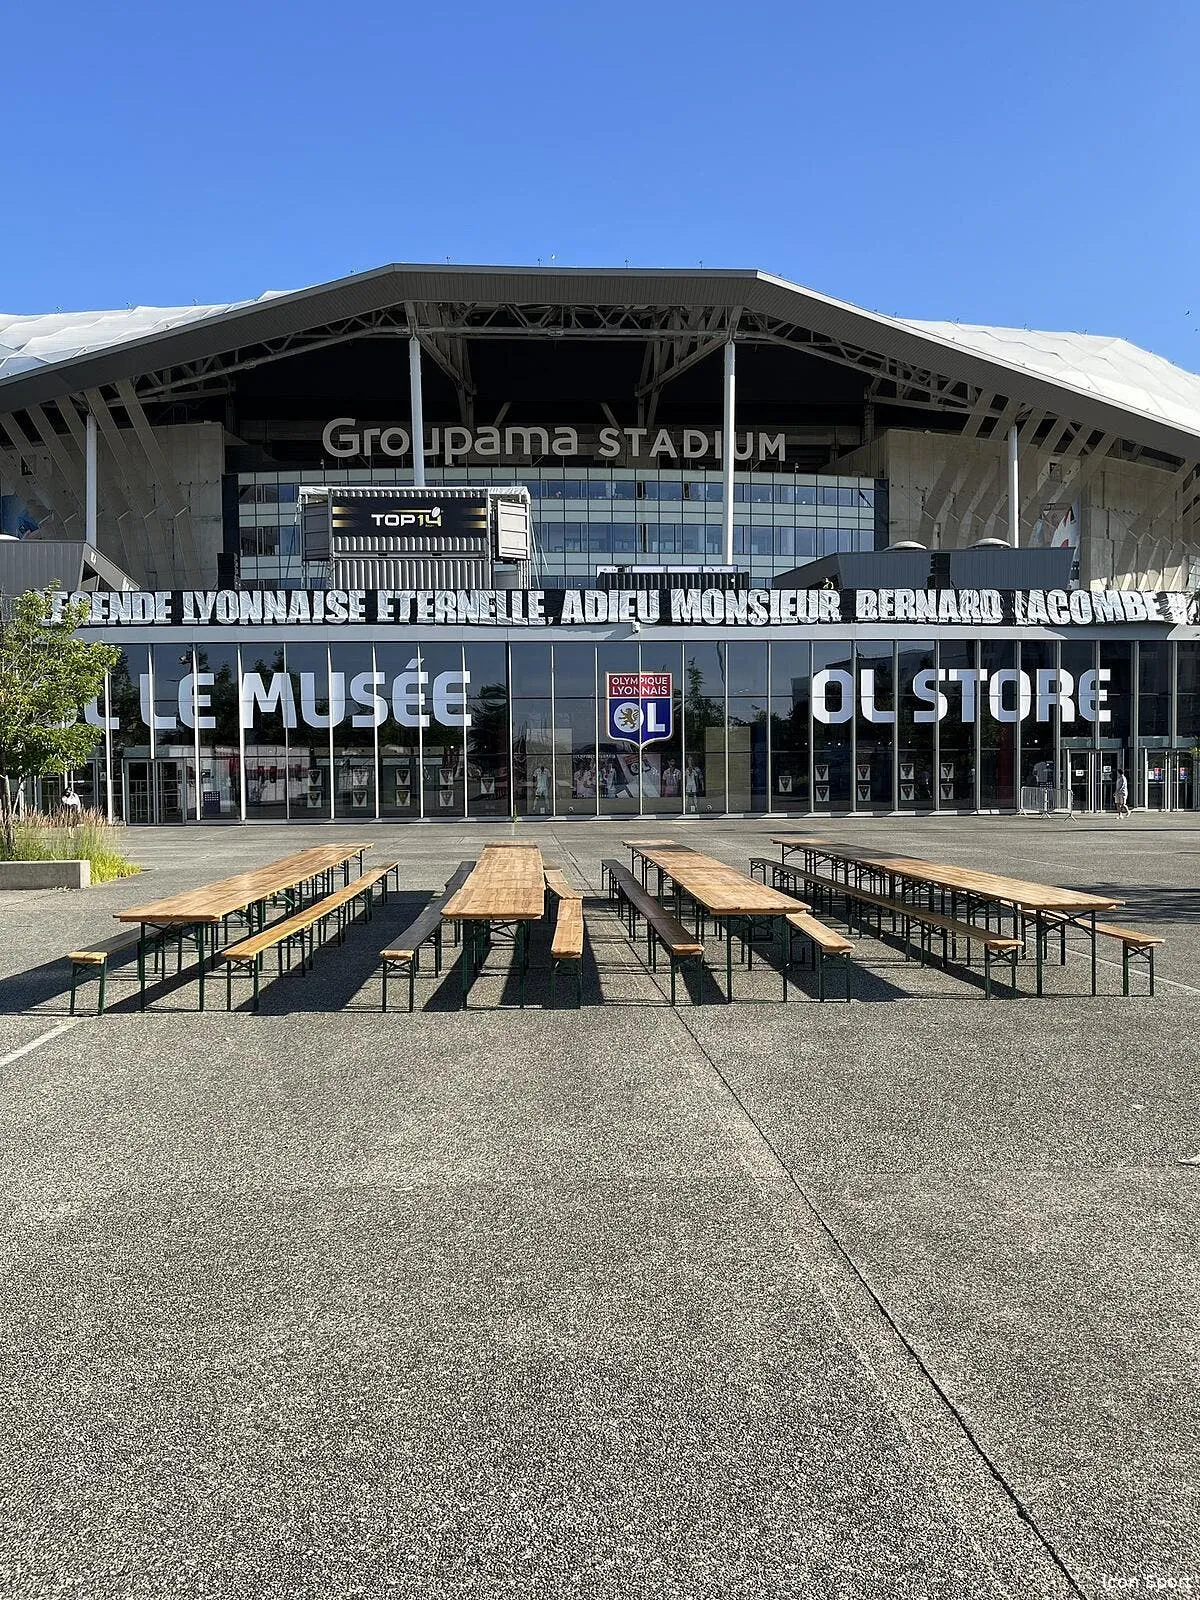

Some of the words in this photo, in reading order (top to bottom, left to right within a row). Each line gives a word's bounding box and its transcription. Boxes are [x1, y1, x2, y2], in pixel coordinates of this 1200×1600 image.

[322, 417, 578, 466] Groupama
[599, 427, 786, 461] STADIUM
[38, 590, 171, 626] EENDE
[182, 590, 366, 624] LYONNAISE
[377, 590, 553, 626] ETERNELLE,
[561, 589, 660, 623] ADIEU
[671, 589, 841, 625] MONSIEUR
[855, 589, 1004, 624] BERNARD
[1015, 589, 1168, 625] LACOMBE
[139, 672, 216, 730] LE
[240, 658, 472, 730] MUSÉE
[611, 676, 668, 686] OLYMPIQUE
[612, 686, 668, 695] LYONNAIS
[812, 669, 897, 724] OL
[913, 668, 1111, 723] STORE
